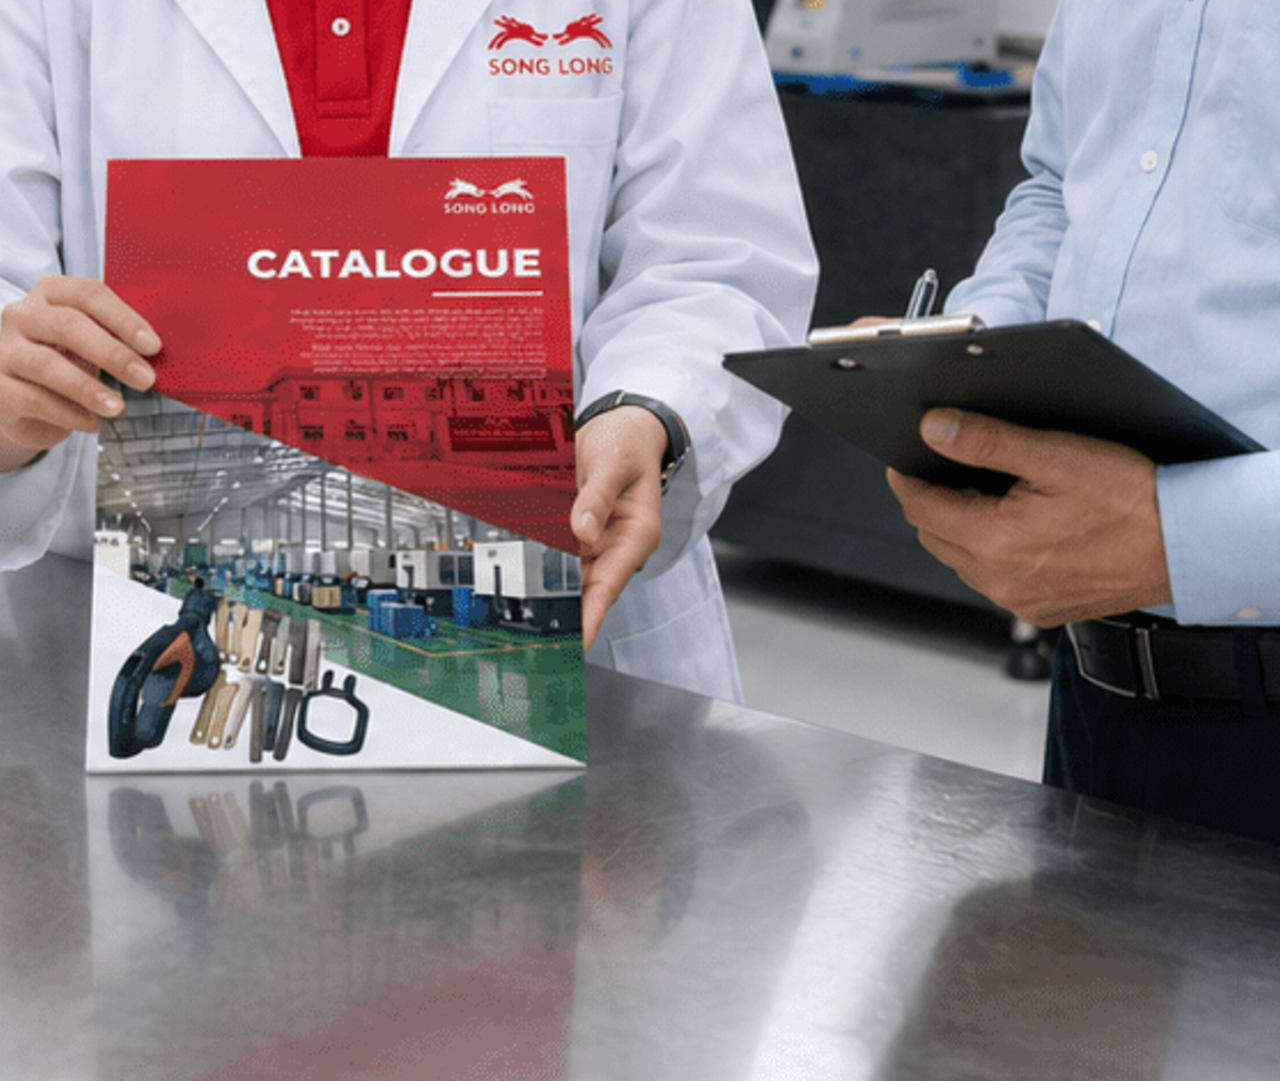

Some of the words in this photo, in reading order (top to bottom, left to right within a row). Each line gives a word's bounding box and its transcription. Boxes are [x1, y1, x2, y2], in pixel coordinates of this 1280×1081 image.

[488, 58, 551, 76] SONG
[558, 57, 614, 75] LONG
[444, 202, 488, 215] SONG
[247, 248, 542, 279] CATALOGUE
